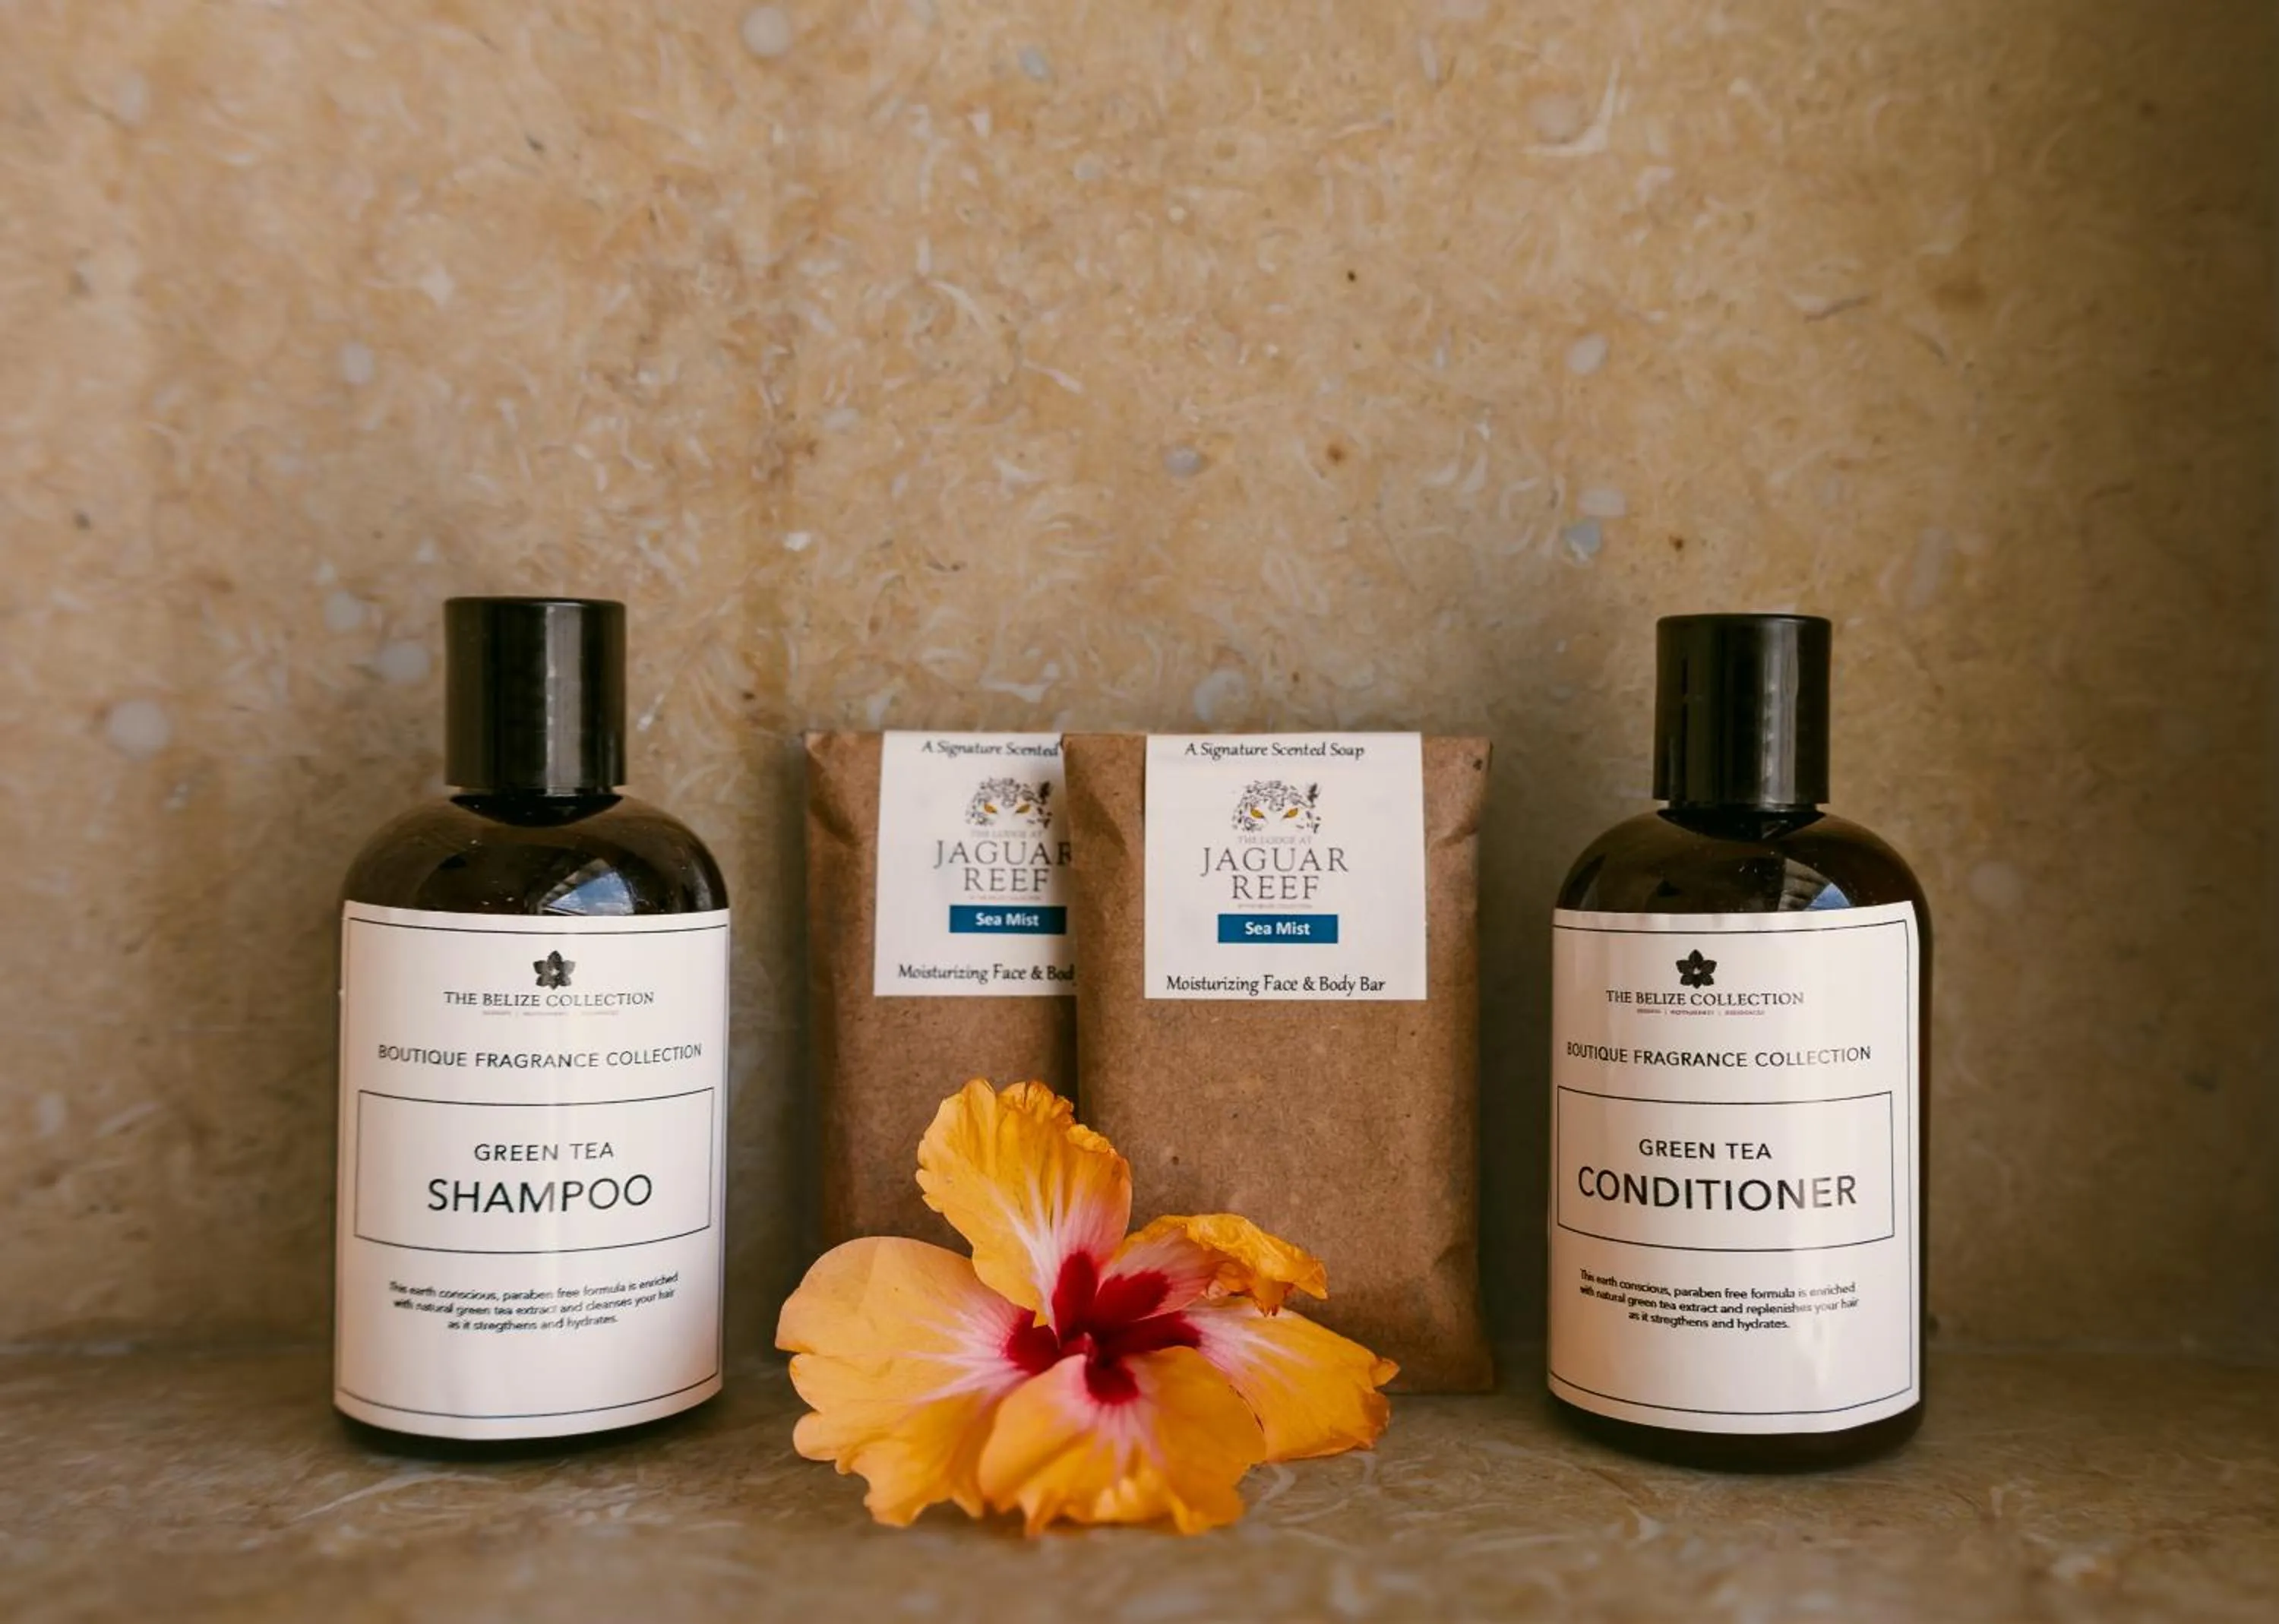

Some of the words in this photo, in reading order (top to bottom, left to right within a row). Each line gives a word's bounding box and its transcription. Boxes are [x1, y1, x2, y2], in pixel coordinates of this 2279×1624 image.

[921, 740, 934, 754] A
[937, 741, 1003, 759] Signature
[1007, 741, 1059, 757] Scented
[1184, 742, 1198, 757] A
[1200, 741, 1268, 761] Signature
[1271, 741, 1327, 757] Scented
[1330, 742, 1365, 760] Soap
[934, 839, 1072, 870] JAGUAR
[1200, 847, 1349, 877] JAGUAR
[963, 867, 1050, 893] REEF
[1231, 874, 1320, 900] REEF
[975, 912, 1002, 927] Sea
[1006, 912, 1039, 927] Mist
[1245, 921, 1272, 936] Sea
[1275, 920, 1310, 936] Mist
[898, 963, 988, 985] Moisturizing
[992, 962, 1027, 980] Face
[1031, 965, 1044, 980] &
[1047, 963, 1075, 981] Bod
[1166, 975, 1260, 997] Moisturizing
[1263, 974, 1298, 992] Face
[1303, 976, 1317, 992] &
[1320, 975, 1356, 997] Body
[1360, 976, 1386, 992] Bar
[444, 991, 478, 1006] THE
[482, 993, 541, 1007] BELIZE
[545, 991, 656, 1008] COLLECTION
[1605, 990, 1632, 1003] THE
[1636, 991, 1686, 1006] BELIZE
[1690, 991, 1804, 1006] COLLECTION
[378, 1044, 467, 1067] BOUTIQUE
[476, 1051, 599, 1069] FRAGRANCE
[605, 1043, 702, 1067] COLLECTION
[1567, 1041, 1628, 1063] BOUTIQUE
[1633, 1049, 1748, 1068] FRAGRANCE
[1755, 1045, 1871, 1067] COLLECTION
[474, 1143, 558, 1161] GREEN
[569, 1142, 614, 1160] TEA
[1639, 1139, 1716, 1160] GREEN
[1725, 1142, 1772, 1161] TEA
[428, 1174, 653, 1214] SHAMPOO
[1578, 1165, 1857, 1212] CONDITIONER
[409, 1286, 437, 1297] earth
[438, 1290, 500, 1301] conscious,
[502, 1288, 555, 1302] paraben
[556, 1287, 580, 1299] free
[583, 1282, 626, 1296] formula
[627, 1281, 637, 1291] is
[639, 1271, 679, 1289] enriched
[1579, 1268, 1595, 1282] This
[1596, 1276, 1618, 1288] earth
[1619, 1280, 1672, 1297] conscious,
[1674, 1287, 1722, 1298] paraben
[1724, 1288, 1748, 1300] free
[1750, 1288, 1796, 1299] formula
[1798, 1288, 1808, 1298] is
[1810, 1281, 1857, 1297] enriched
[416, 1302, 454, 1314] natural
[456, 1306, 491, 1317] green
[493, 1306, 514, 1316] tea
[515, 1304, 558, 1316] extract
[559, 1303, 583, 1314] and
[585, 1297, 633, 1312] cleanses
[634, 1293, 656, 1307] your
[658, 1288, 676, 1300] hair
[1579, 1285, 1595, 1297] with
[1596, 1291, 1626, 1303] natural
[1627, 1296, 1658, 1308] green
[1659, 1300, 1677, 1311] tea
[1678, 1303, 1719, 1314] extract
[1720, 1303, 1743, 1314] and
[1746, 1302, 1813, 1316] replenishes
[1814, 1301, 1839, 1315] your
[1841, 1297, 1860, 1309] hair
[447, 1321, 460, 1330] as
[462, 1320, 471, 1330] it
[540, 1317, 565, 1330] and
[1628, 1311, 1640, 1321] as
[1641, 1311, 1649, 1322] it
[1711, 1318, 1735, 1329] and
[1737, 1317, 1791, 1331] hydrates.
